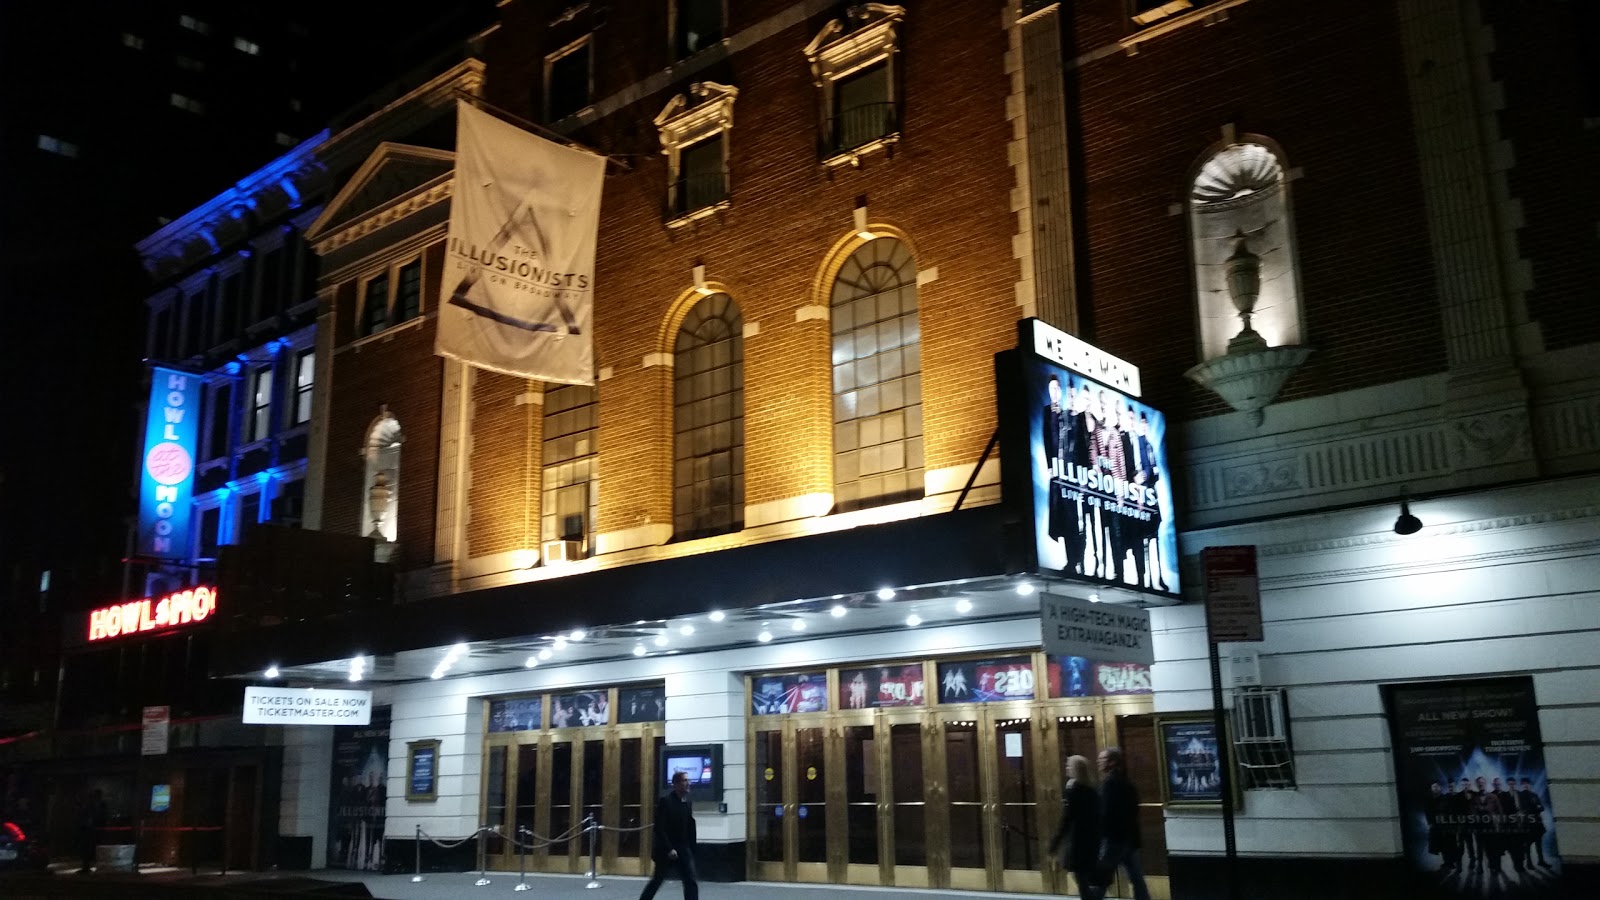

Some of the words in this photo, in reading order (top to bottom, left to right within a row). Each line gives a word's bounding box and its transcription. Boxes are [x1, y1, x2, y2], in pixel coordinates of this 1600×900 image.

[450, 237, 589, 289] ILLUSIONISTS
[514, 245, 538, 260] THE
[163, 374, 186, 440] HOWL
[1051, 457, 1157, 506] ILLUSIONISTS
[1061, 487, 1085, 503] LIVE
[1087, 496, 1101, 508] ON
[1104, 501, 1151, 522] BROADWAY
[153, 485, 178, 552] MOON
[88, 600, 155, 641] HOWL
[1117, 614, 1148, 633] MAGIC
[251, 696, 293, 706] TICKETS
[296, 697, 311, 706] ON
[314, 698, 339, 707] SALE
[342, 699, 366, 707] NOW
[257, 707, 360, 718] TICKETMASTER.COM
[1418, 711, 1440, 722] ALL
[1441, 710, 1469, 721] NEW
[1435, 814, 1537, 825] ILLUSIONISTS
